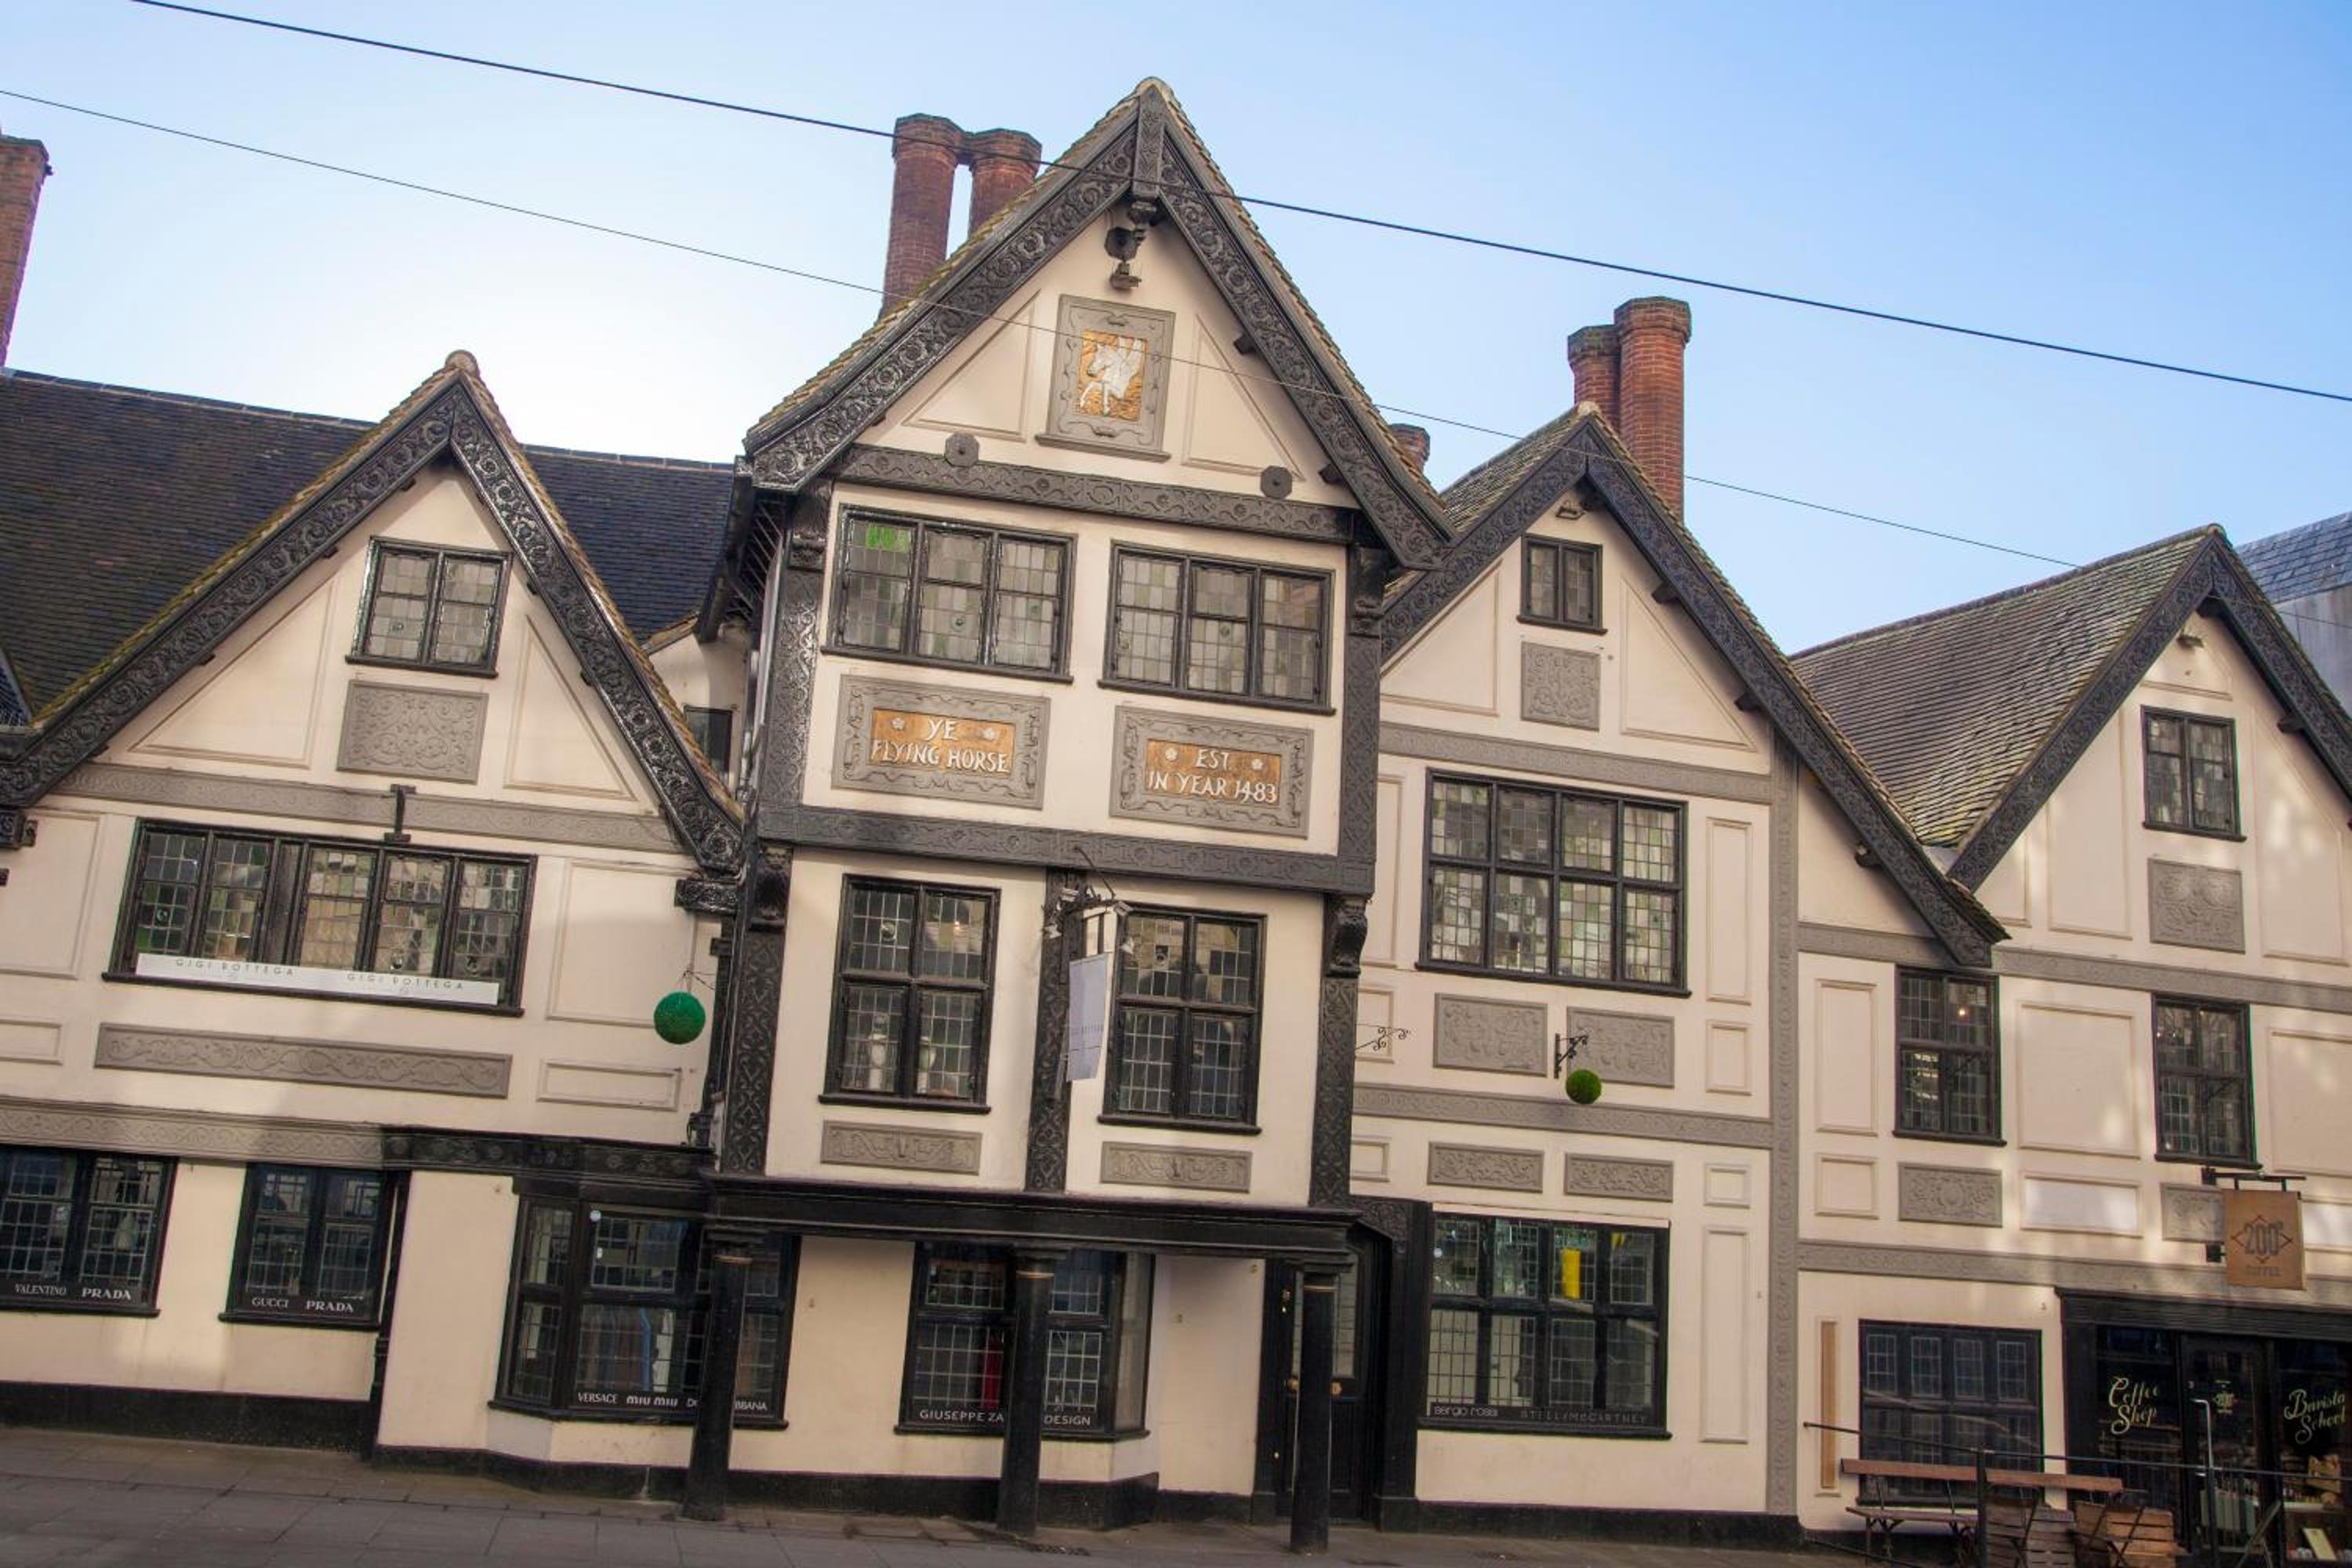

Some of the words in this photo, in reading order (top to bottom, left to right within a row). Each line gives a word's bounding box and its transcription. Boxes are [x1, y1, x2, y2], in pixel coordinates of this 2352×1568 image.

[925, 717, 959, 741] YE
[870, 739, 940, 764] FLYING
[947, 748, 1011, 773] HORSE
[1148, 771, 1169, 790] IN
[1176, 773, 1226, 796] YEAR
[1233, 779, 1278, 804] 1483
[221, 963, 294, 975] BOTTEGA
[393, 977, 463, 991] BOTTEGA
[14, 1283, 67, 1296] VALENTINO
[82, 1287, 132, 1301] PRADA
[252, 1297, 289, 1308] GUCCI
[306, 1300, 354, 1313] PRADA
[578, 1392, 617, 1404] VERSACE
[2108, 1376, 2158, 1407] Coffee
[2284, 1388, 2346, 1420] Barista
[920, 1409, 984, 1421] GIUSEPPE
[1044, 1415, 1091, 1426] DESIGN
[2111, 1404, 2158, 1435] Shop
[2295, 1405, 2346, 1444] School
